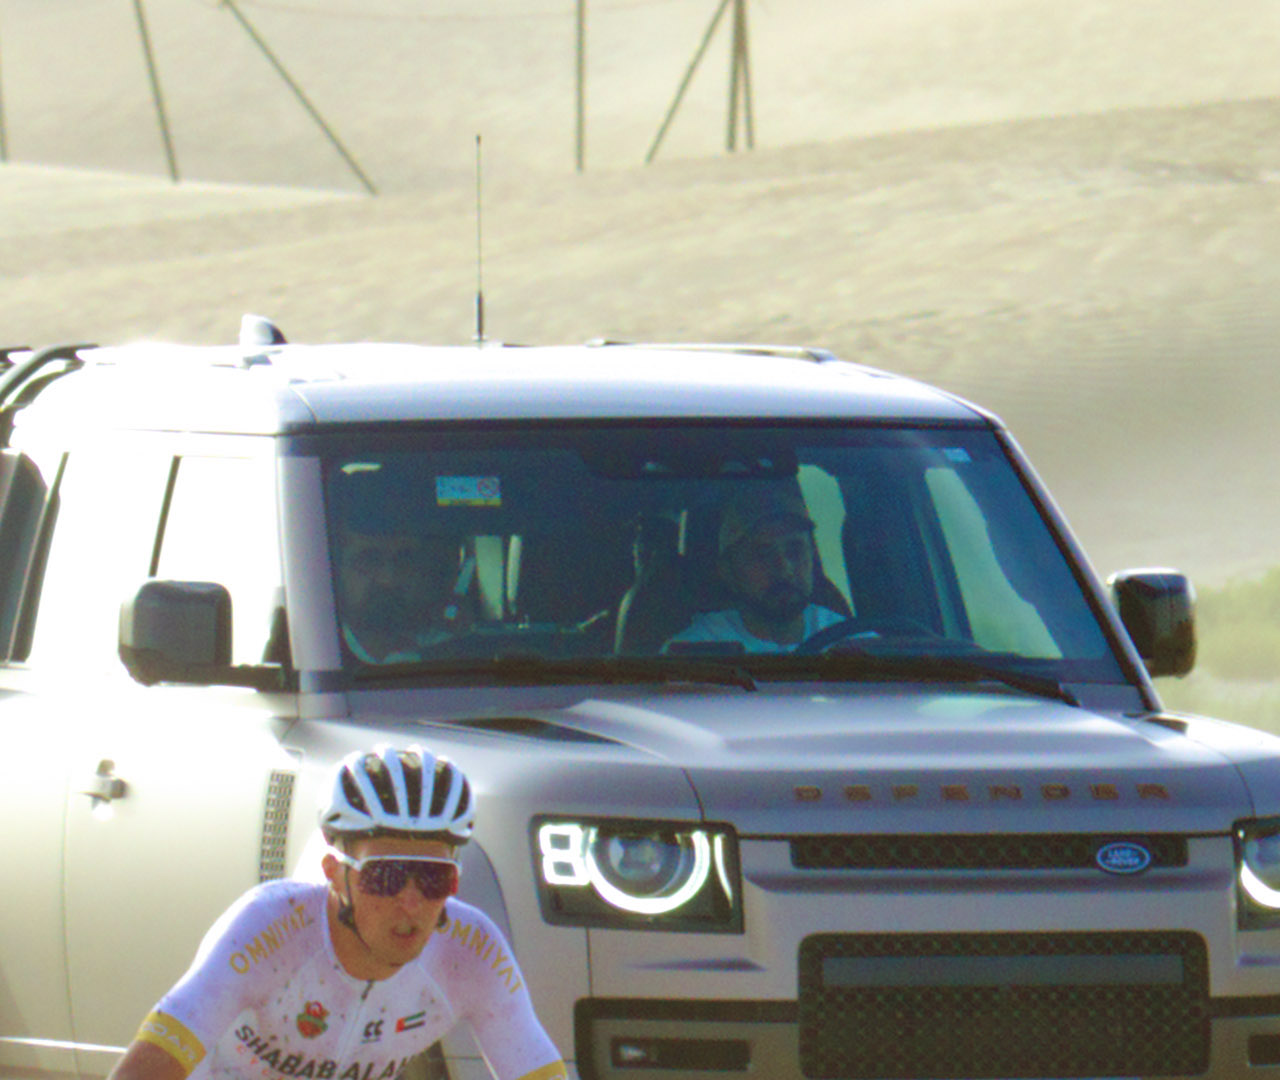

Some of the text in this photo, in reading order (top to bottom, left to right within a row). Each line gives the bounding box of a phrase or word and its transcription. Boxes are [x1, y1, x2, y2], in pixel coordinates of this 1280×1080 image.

[794, 783, 1170, 801] DEFENDER
[229, 904, 308, 974] OMNIYAT
[235, 1025, 337, 1080] SHABAB
